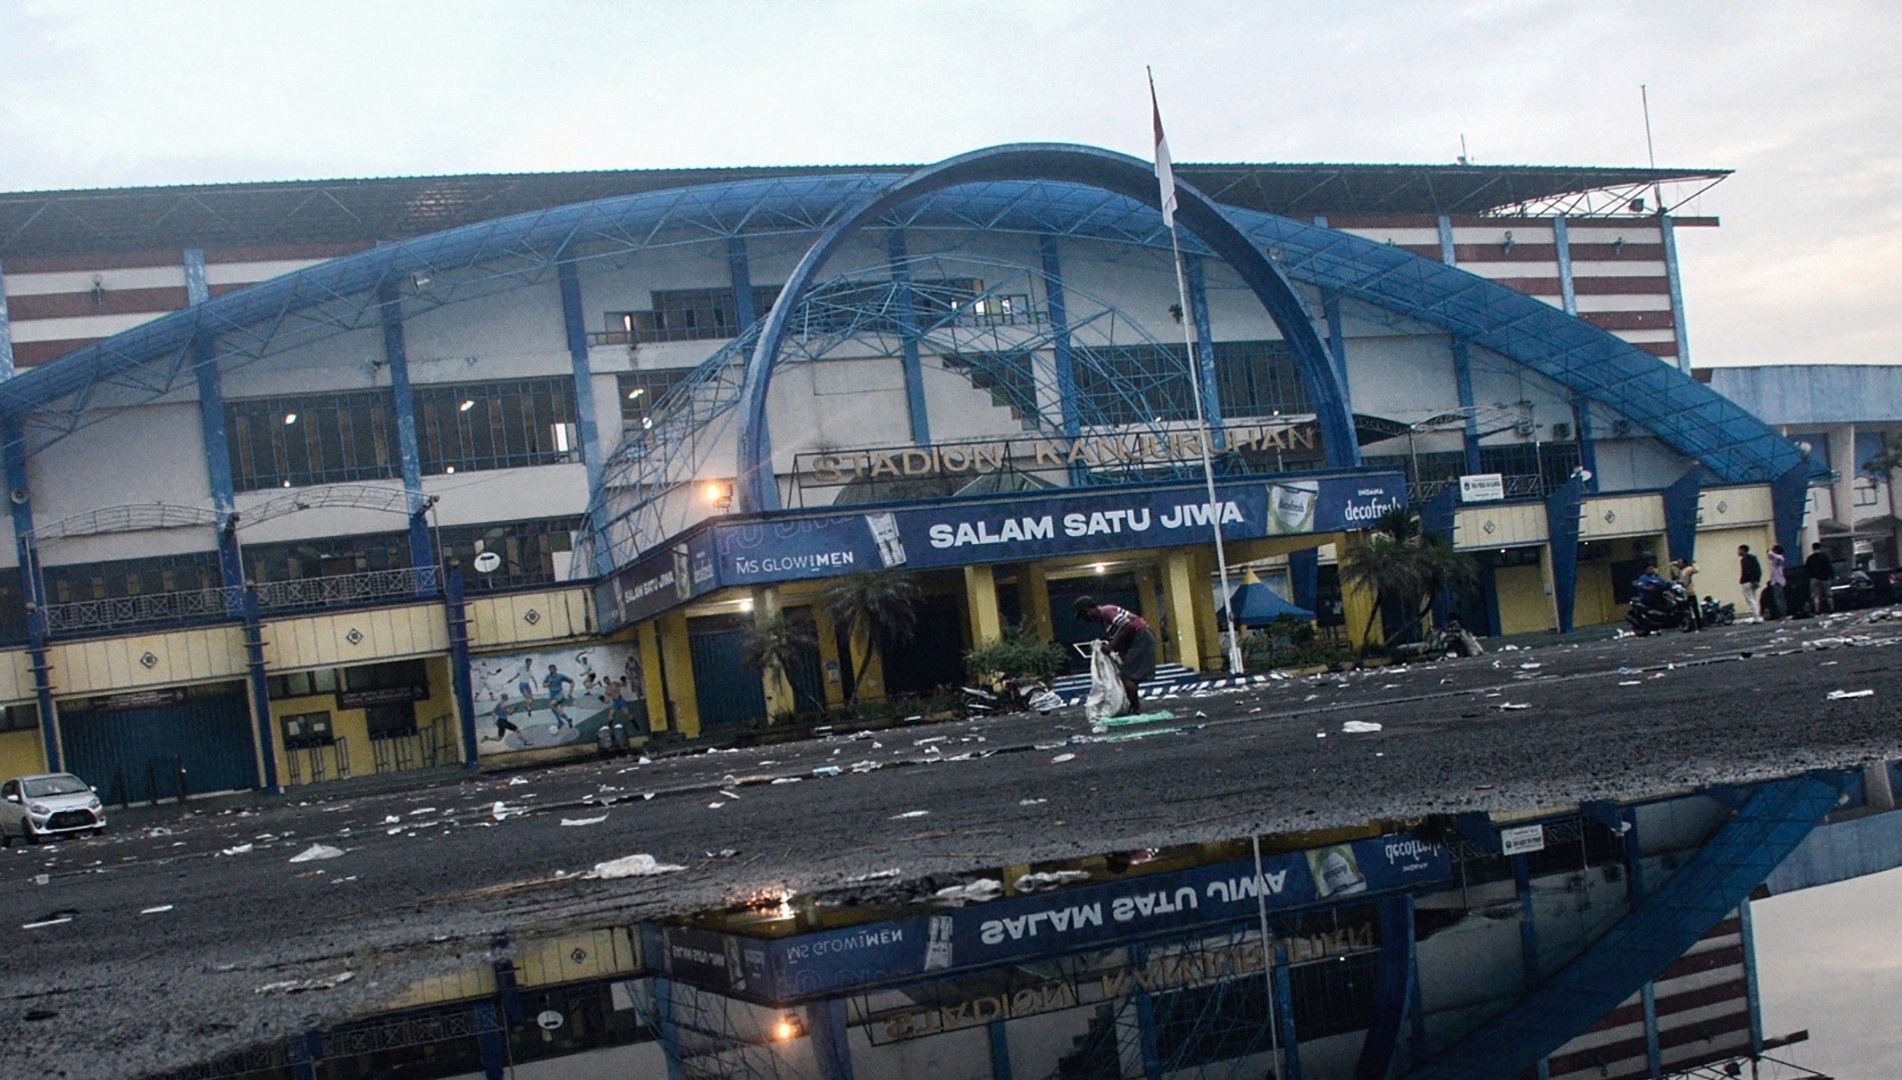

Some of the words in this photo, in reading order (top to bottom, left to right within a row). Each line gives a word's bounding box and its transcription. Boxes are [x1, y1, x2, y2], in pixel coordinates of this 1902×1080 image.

[812, 445, 1003, 482] STADION
[1035, 426, 1314, 465] KANJURUHAN
[929, 515, 1053, 548] SALAM
[1063, 508, 1150, 537] SATU
[1160, 501, 1244, 529] JIWA
[736, 559, 758, 574] MS
[762, 556, 807, 572] GLOW
